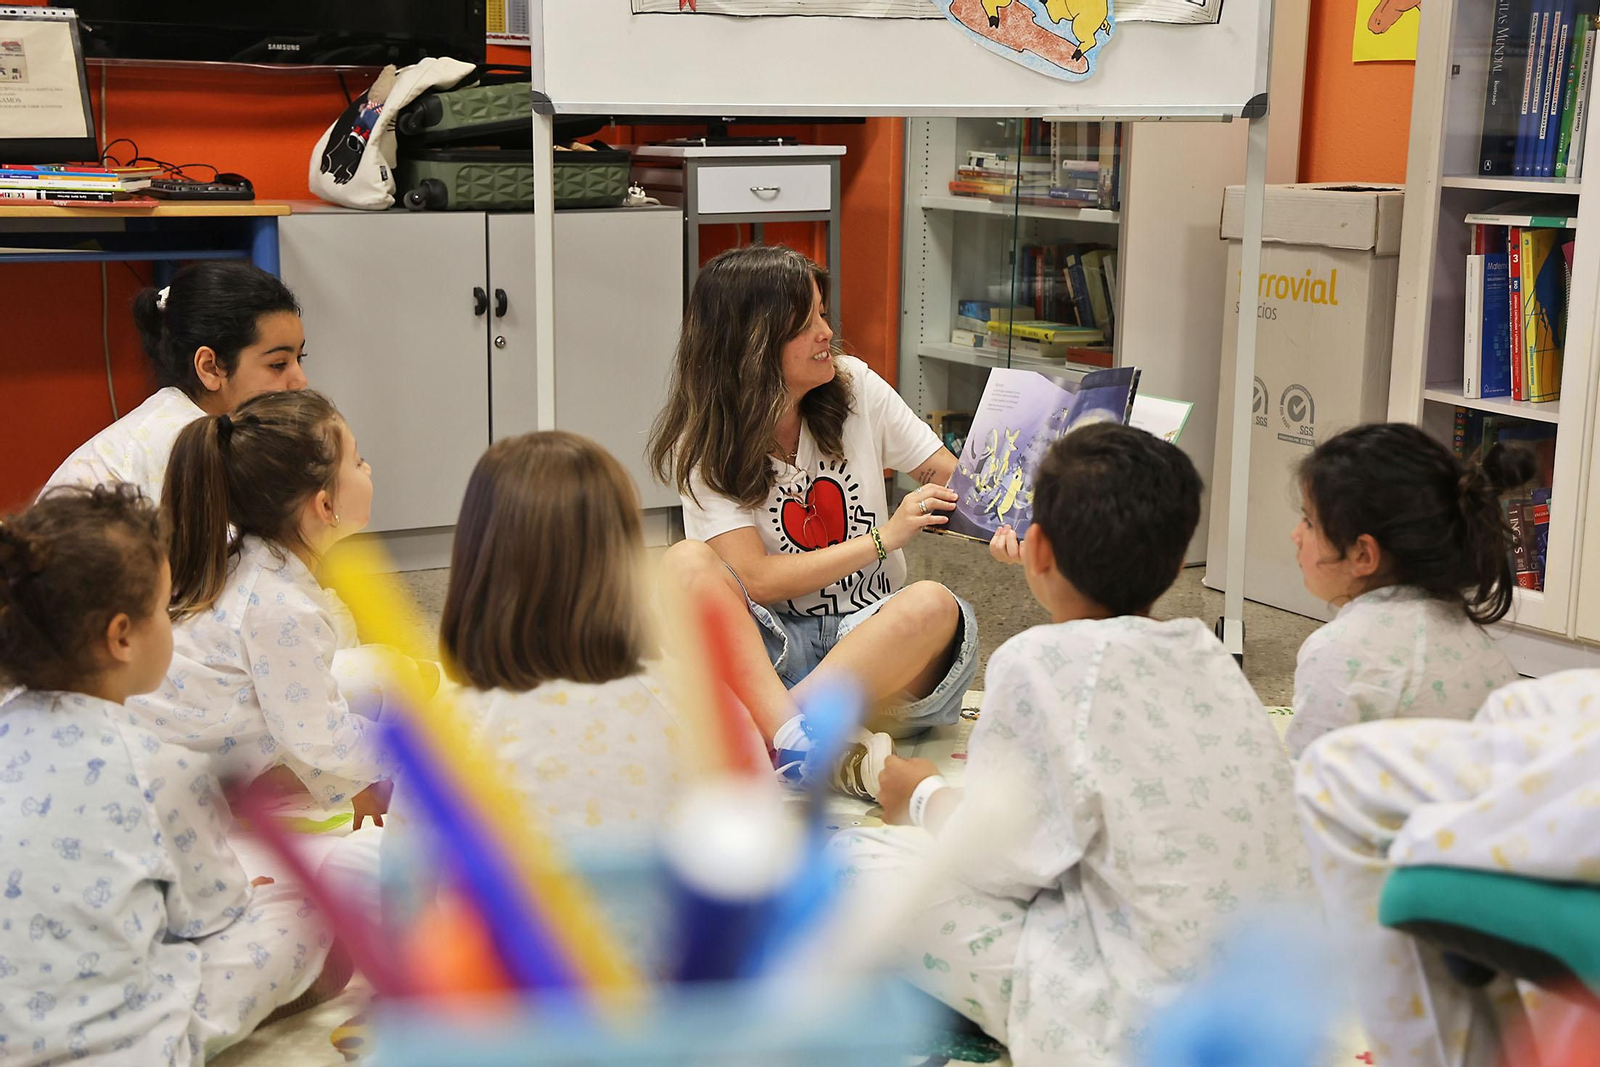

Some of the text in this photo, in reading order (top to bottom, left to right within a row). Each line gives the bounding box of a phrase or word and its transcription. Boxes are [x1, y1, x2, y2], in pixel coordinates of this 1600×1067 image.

[1492, 0, 1509, 106] TLAS MUNDIAL Ilustrado
[1580, 71, 1588, 91] CUENTOS
[1512, 254, 1518, 263] 3
[1238, 268, 1338, 305] rrovial
[1235, 301, 1277, 320] scios
[1256, 415, 1267, 427] SGS
[1300, 425, 1313, 437] SGS
